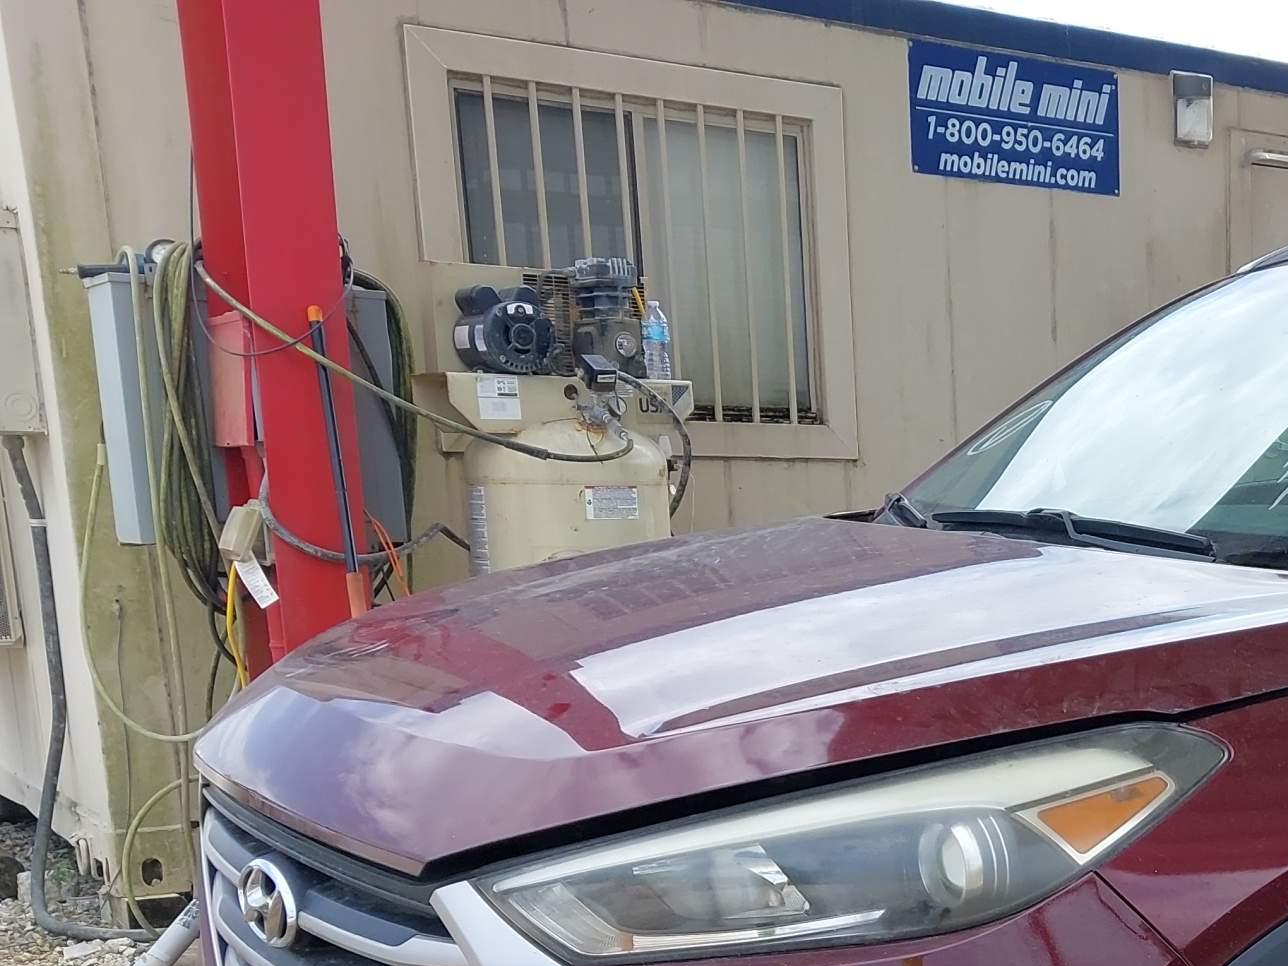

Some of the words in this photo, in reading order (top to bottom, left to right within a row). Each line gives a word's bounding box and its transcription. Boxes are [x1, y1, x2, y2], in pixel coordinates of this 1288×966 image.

[916, 56, 1034, 114] mobile
[1037, 79, 1112, 125] mini
[927, 115, 1104, 161] 1-800-950-6464
[939, 152, 1097, 189] mobilemini.com
[639, 397, 671, 413] US
